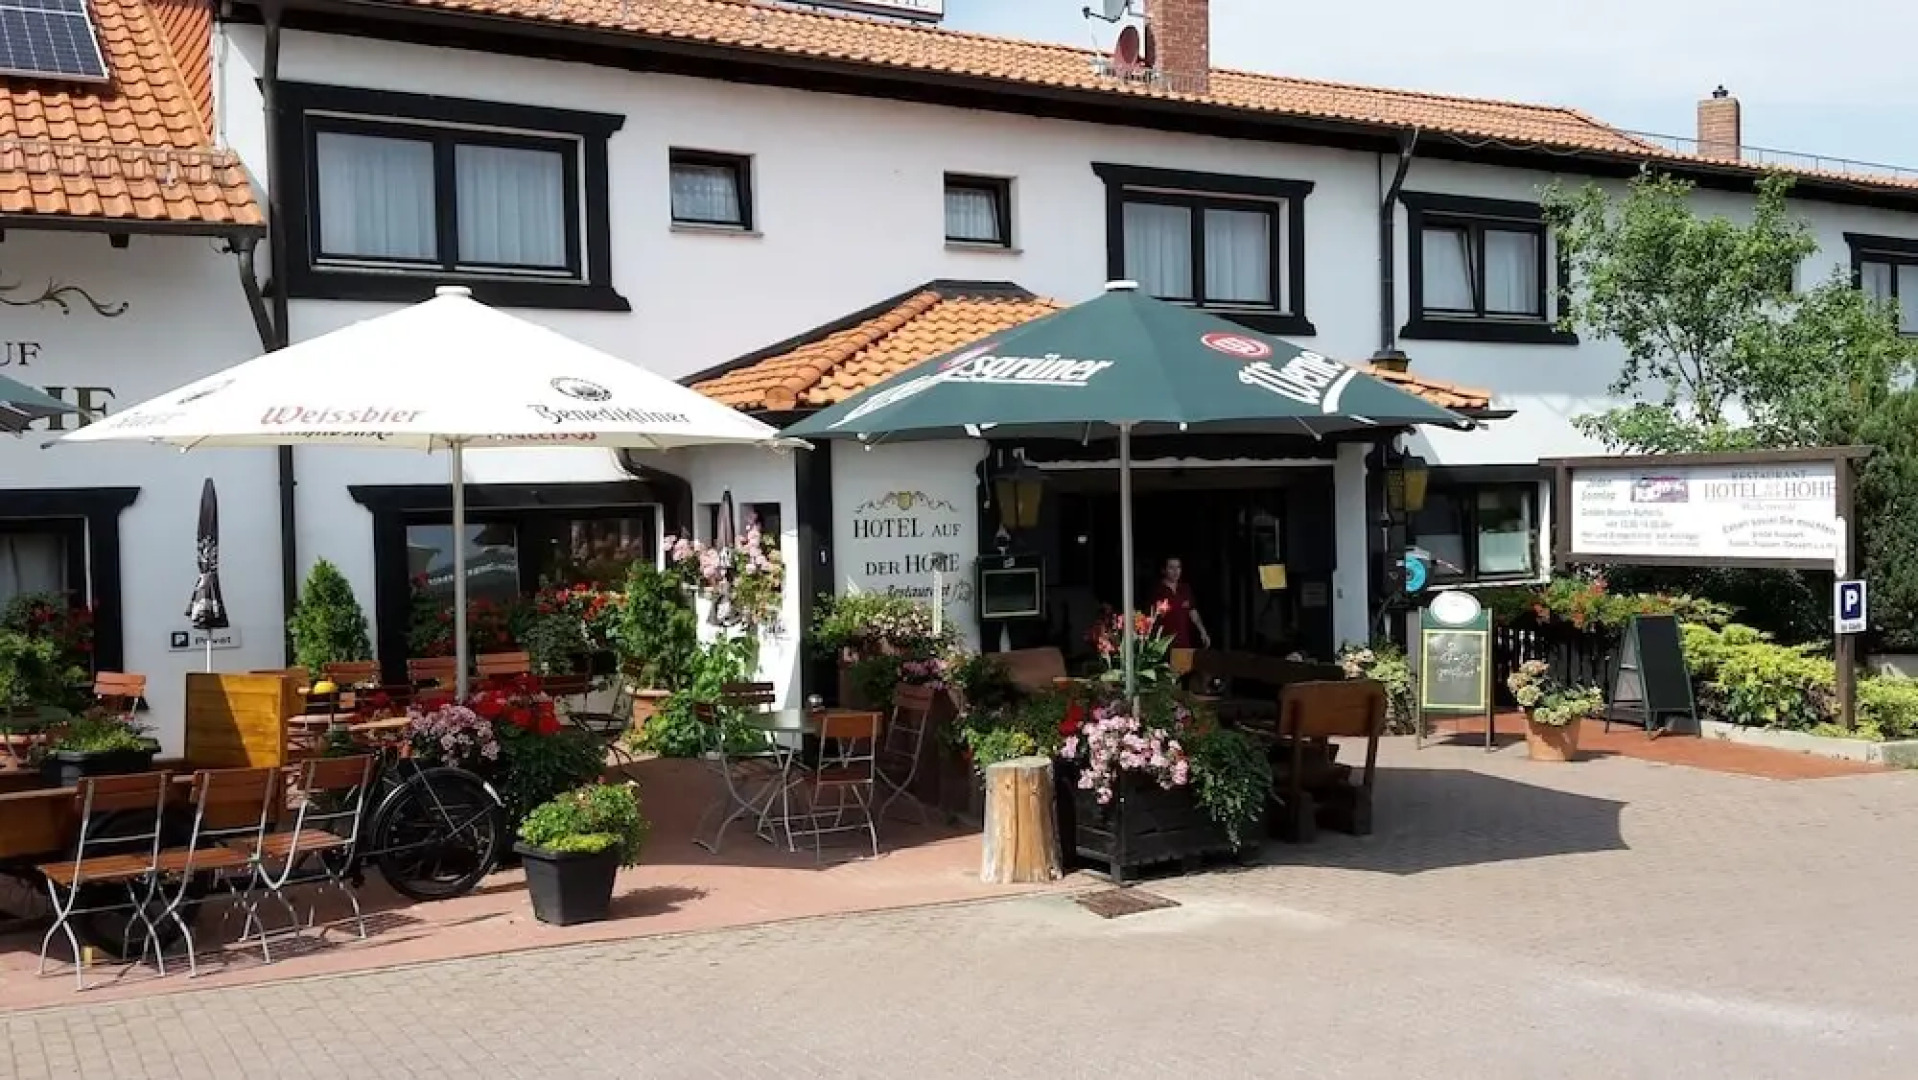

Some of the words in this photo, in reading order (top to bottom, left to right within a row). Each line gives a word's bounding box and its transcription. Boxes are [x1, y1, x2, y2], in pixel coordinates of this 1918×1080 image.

[260, 404, 427, 425] Weissbier
[1704, 482, 1756, 500] HOTEL
[853, 518, 924, 538] HOTEL
[931, 523, 961, 537] AUF
[866, 561, 900, 576] DER
[1845, 589, 1858, 612] P
